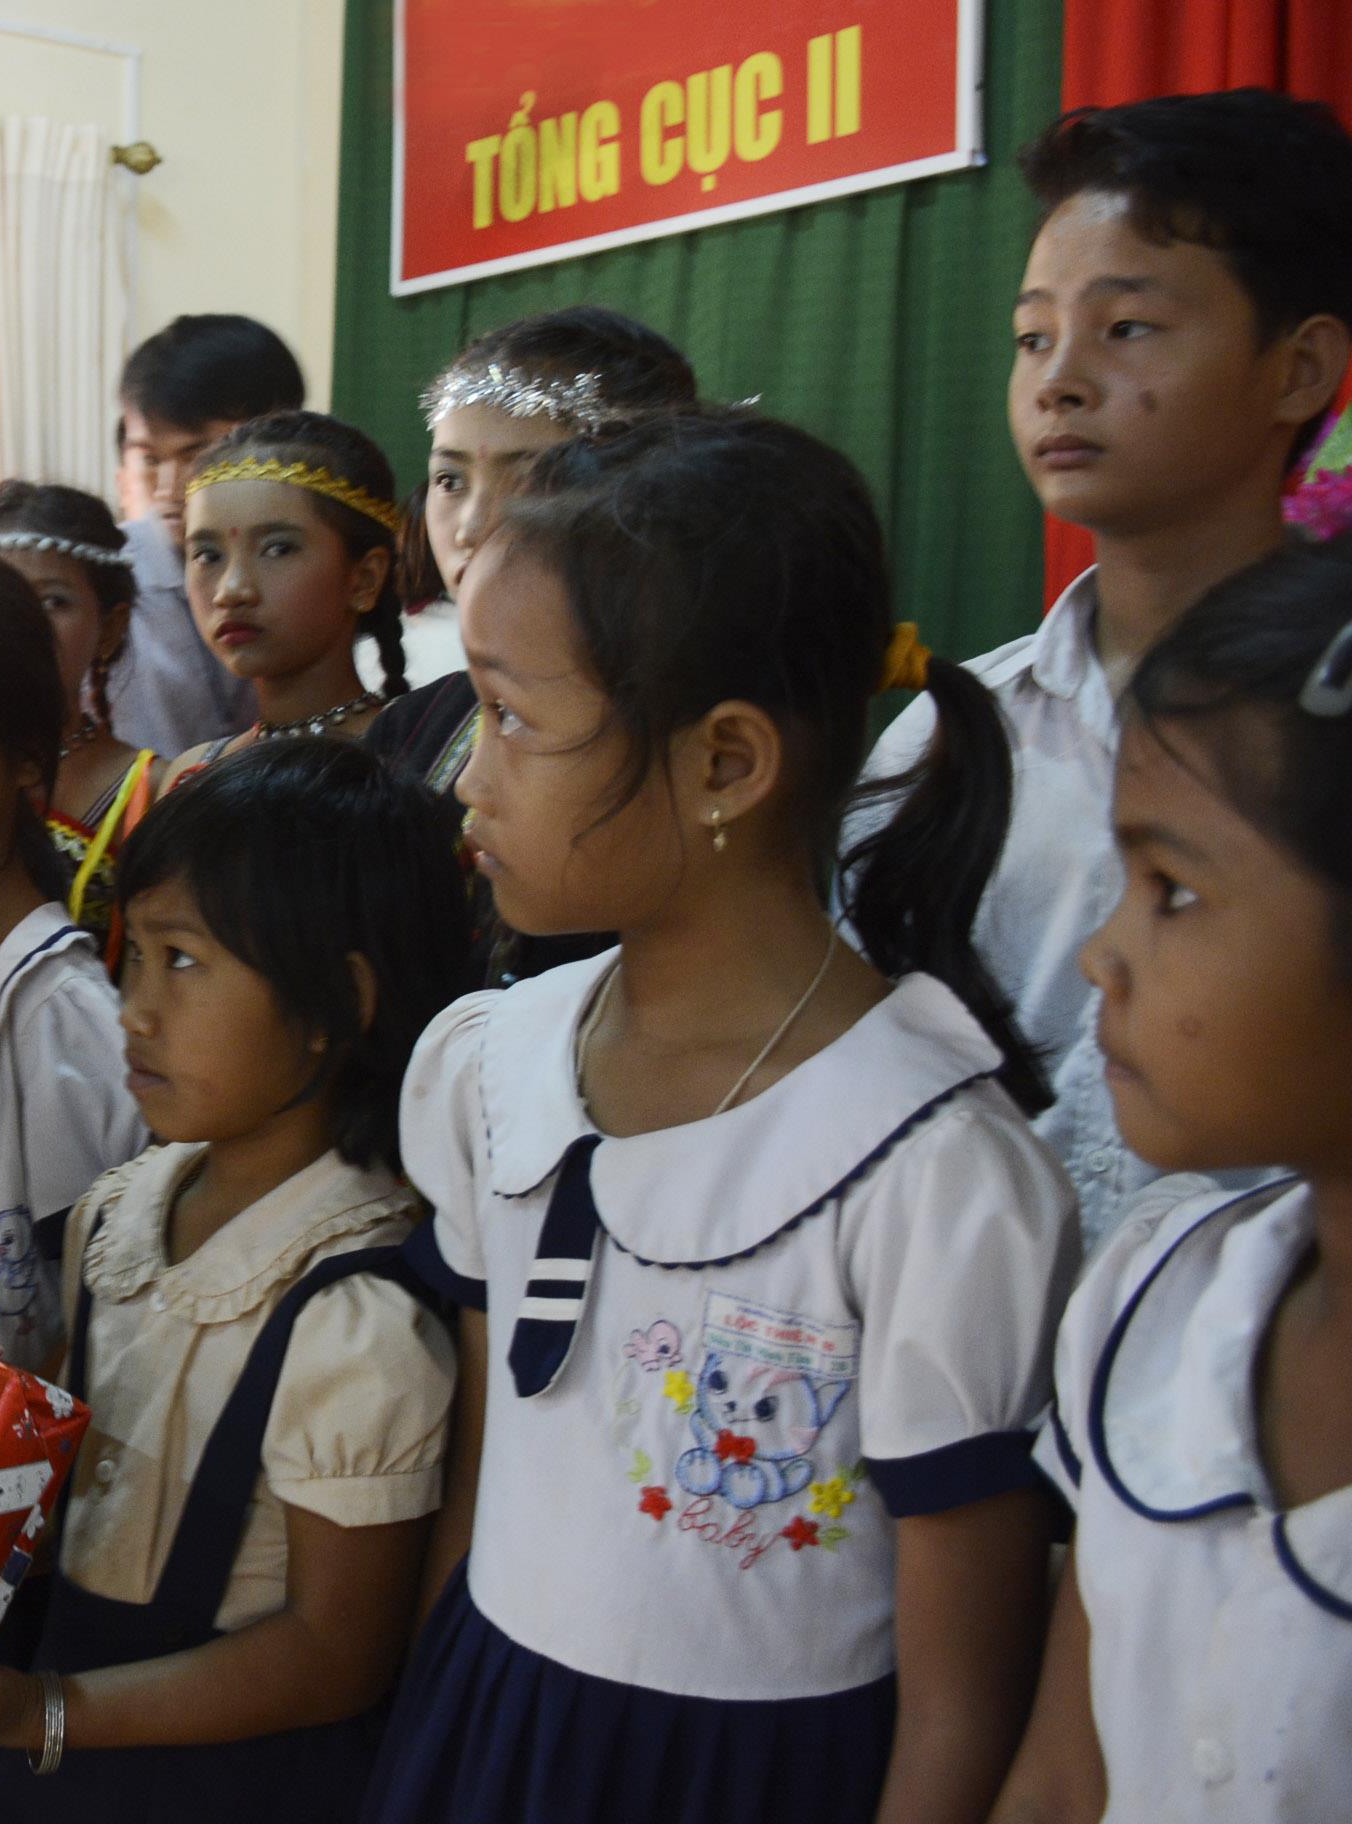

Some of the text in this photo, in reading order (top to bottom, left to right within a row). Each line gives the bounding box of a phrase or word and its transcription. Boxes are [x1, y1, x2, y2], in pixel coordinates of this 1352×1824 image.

[465, 24, 862, 229] TỔNG CỤC II
[678, 1497, 778, 1570] baby
